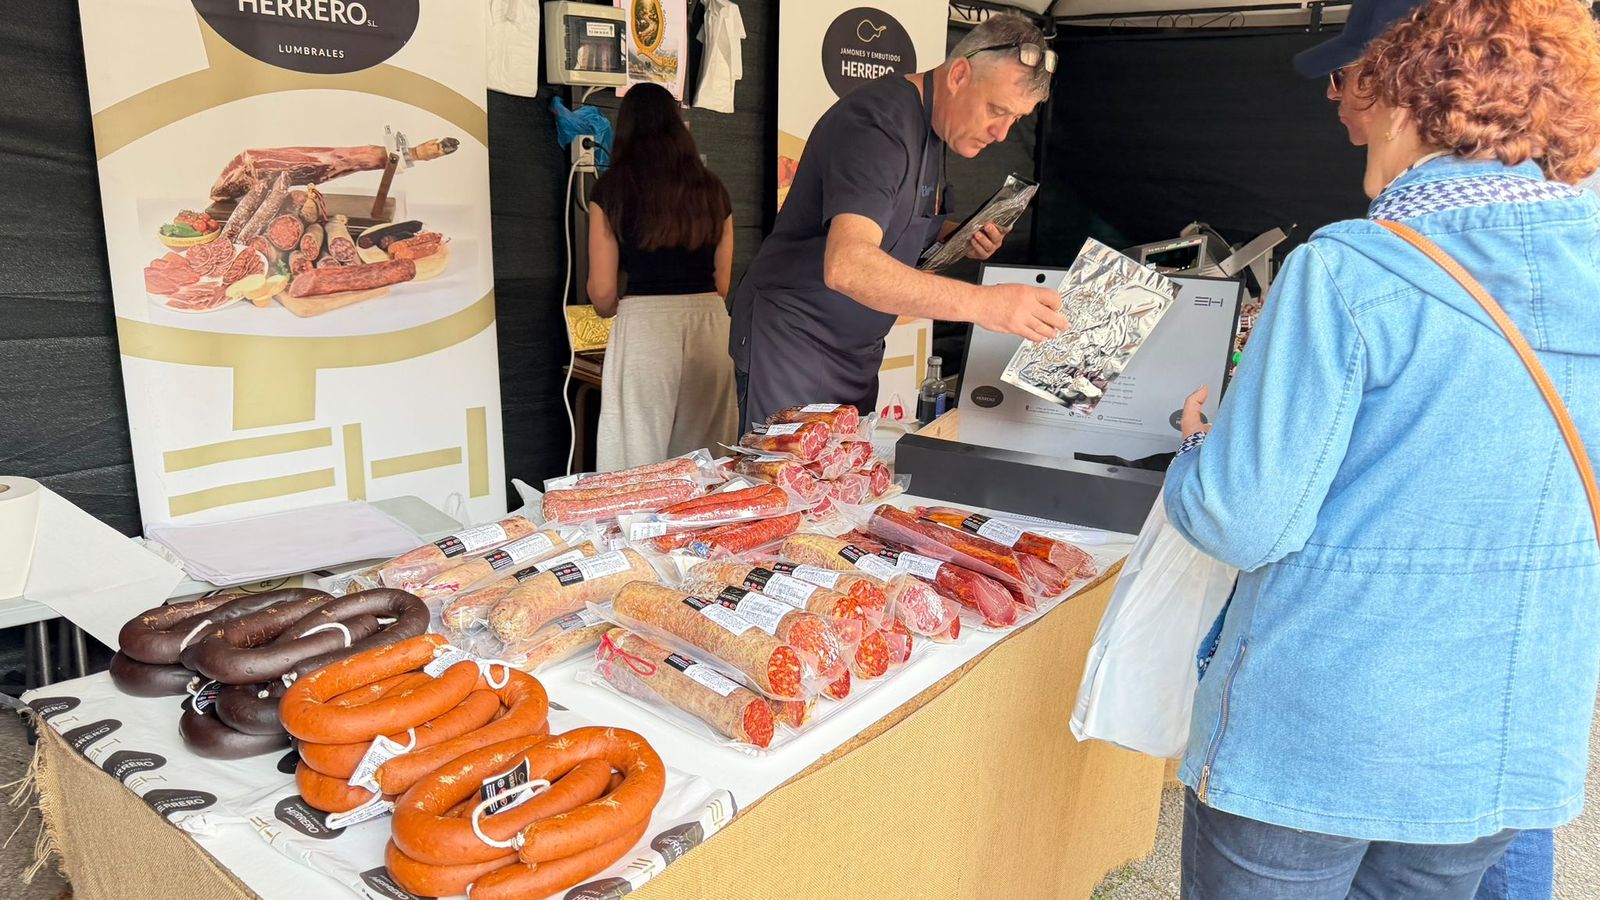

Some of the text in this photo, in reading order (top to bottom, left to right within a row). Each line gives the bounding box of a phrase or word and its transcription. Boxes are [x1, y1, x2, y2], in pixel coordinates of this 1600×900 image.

[238, 0, 368, 26] HERRERO
[278, 44, 345, 59] LUMBRALES
[840, 47, 866, 58] JAMONES
[871, 51, 901, 63] EMBUTIDOS
[156, 798, 205, 813] ERRERO
